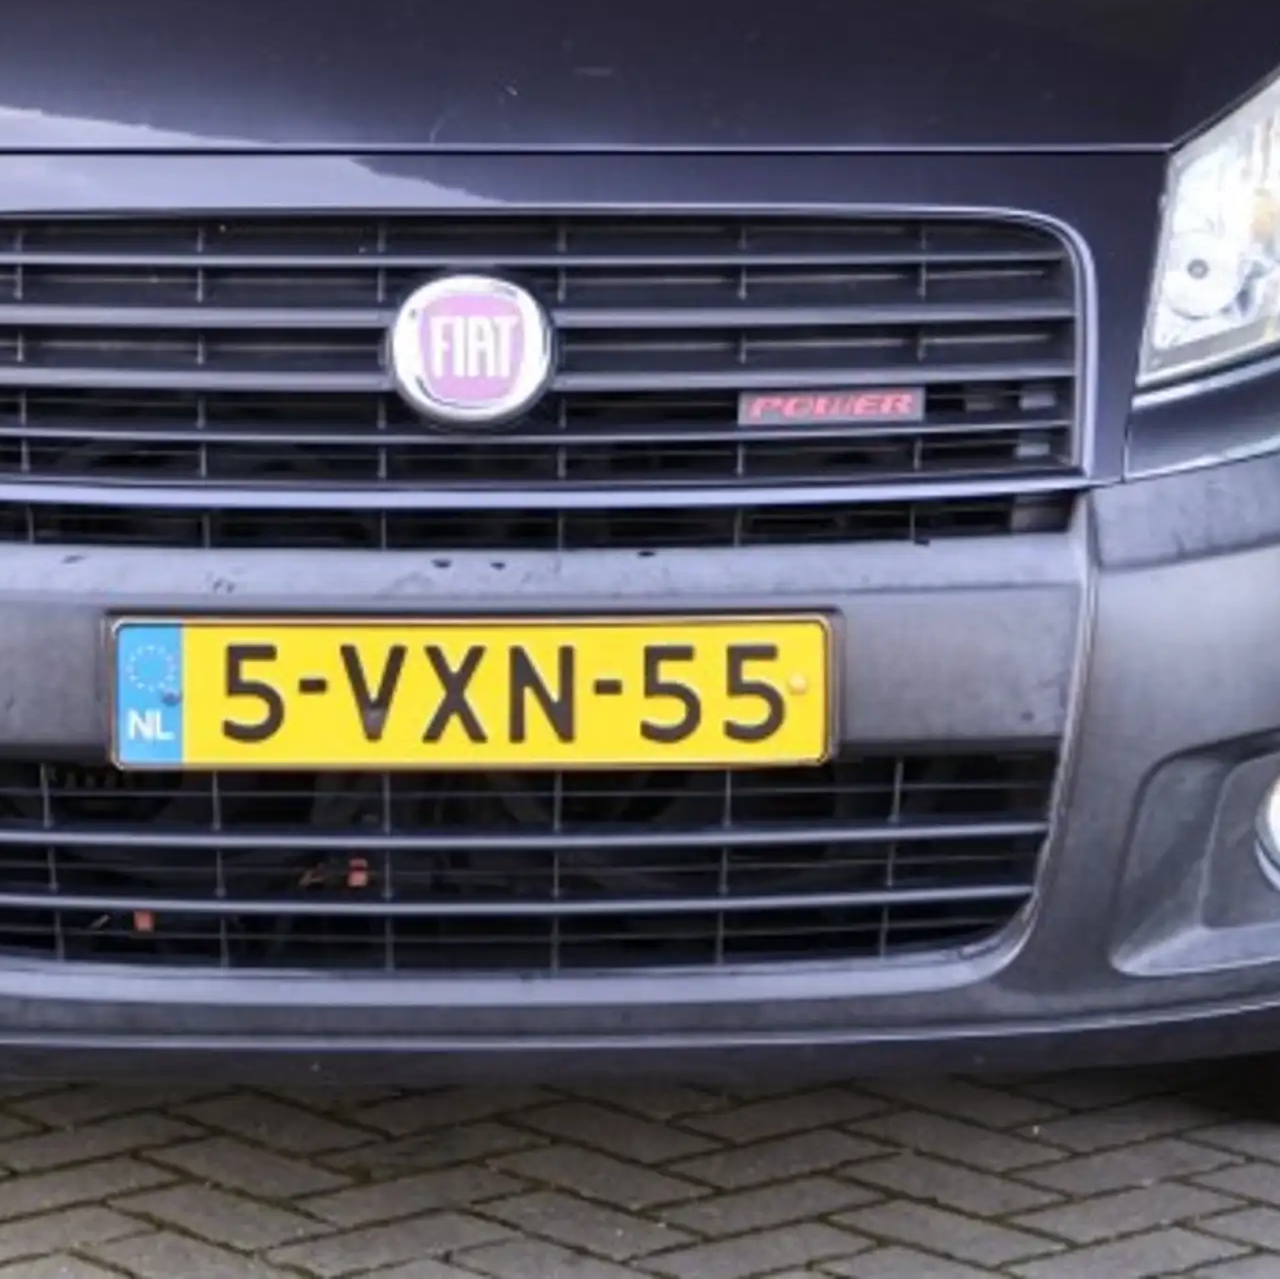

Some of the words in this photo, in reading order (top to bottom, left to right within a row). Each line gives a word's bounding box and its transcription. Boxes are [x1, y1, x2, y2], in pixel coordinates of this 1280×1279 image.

[430, 315, 519, 379] FIAT
[749, 393, 914, 418] POWER
[222, 644, 785, 743] 5-VXN-55
[126, 711, 173, 740] NL
